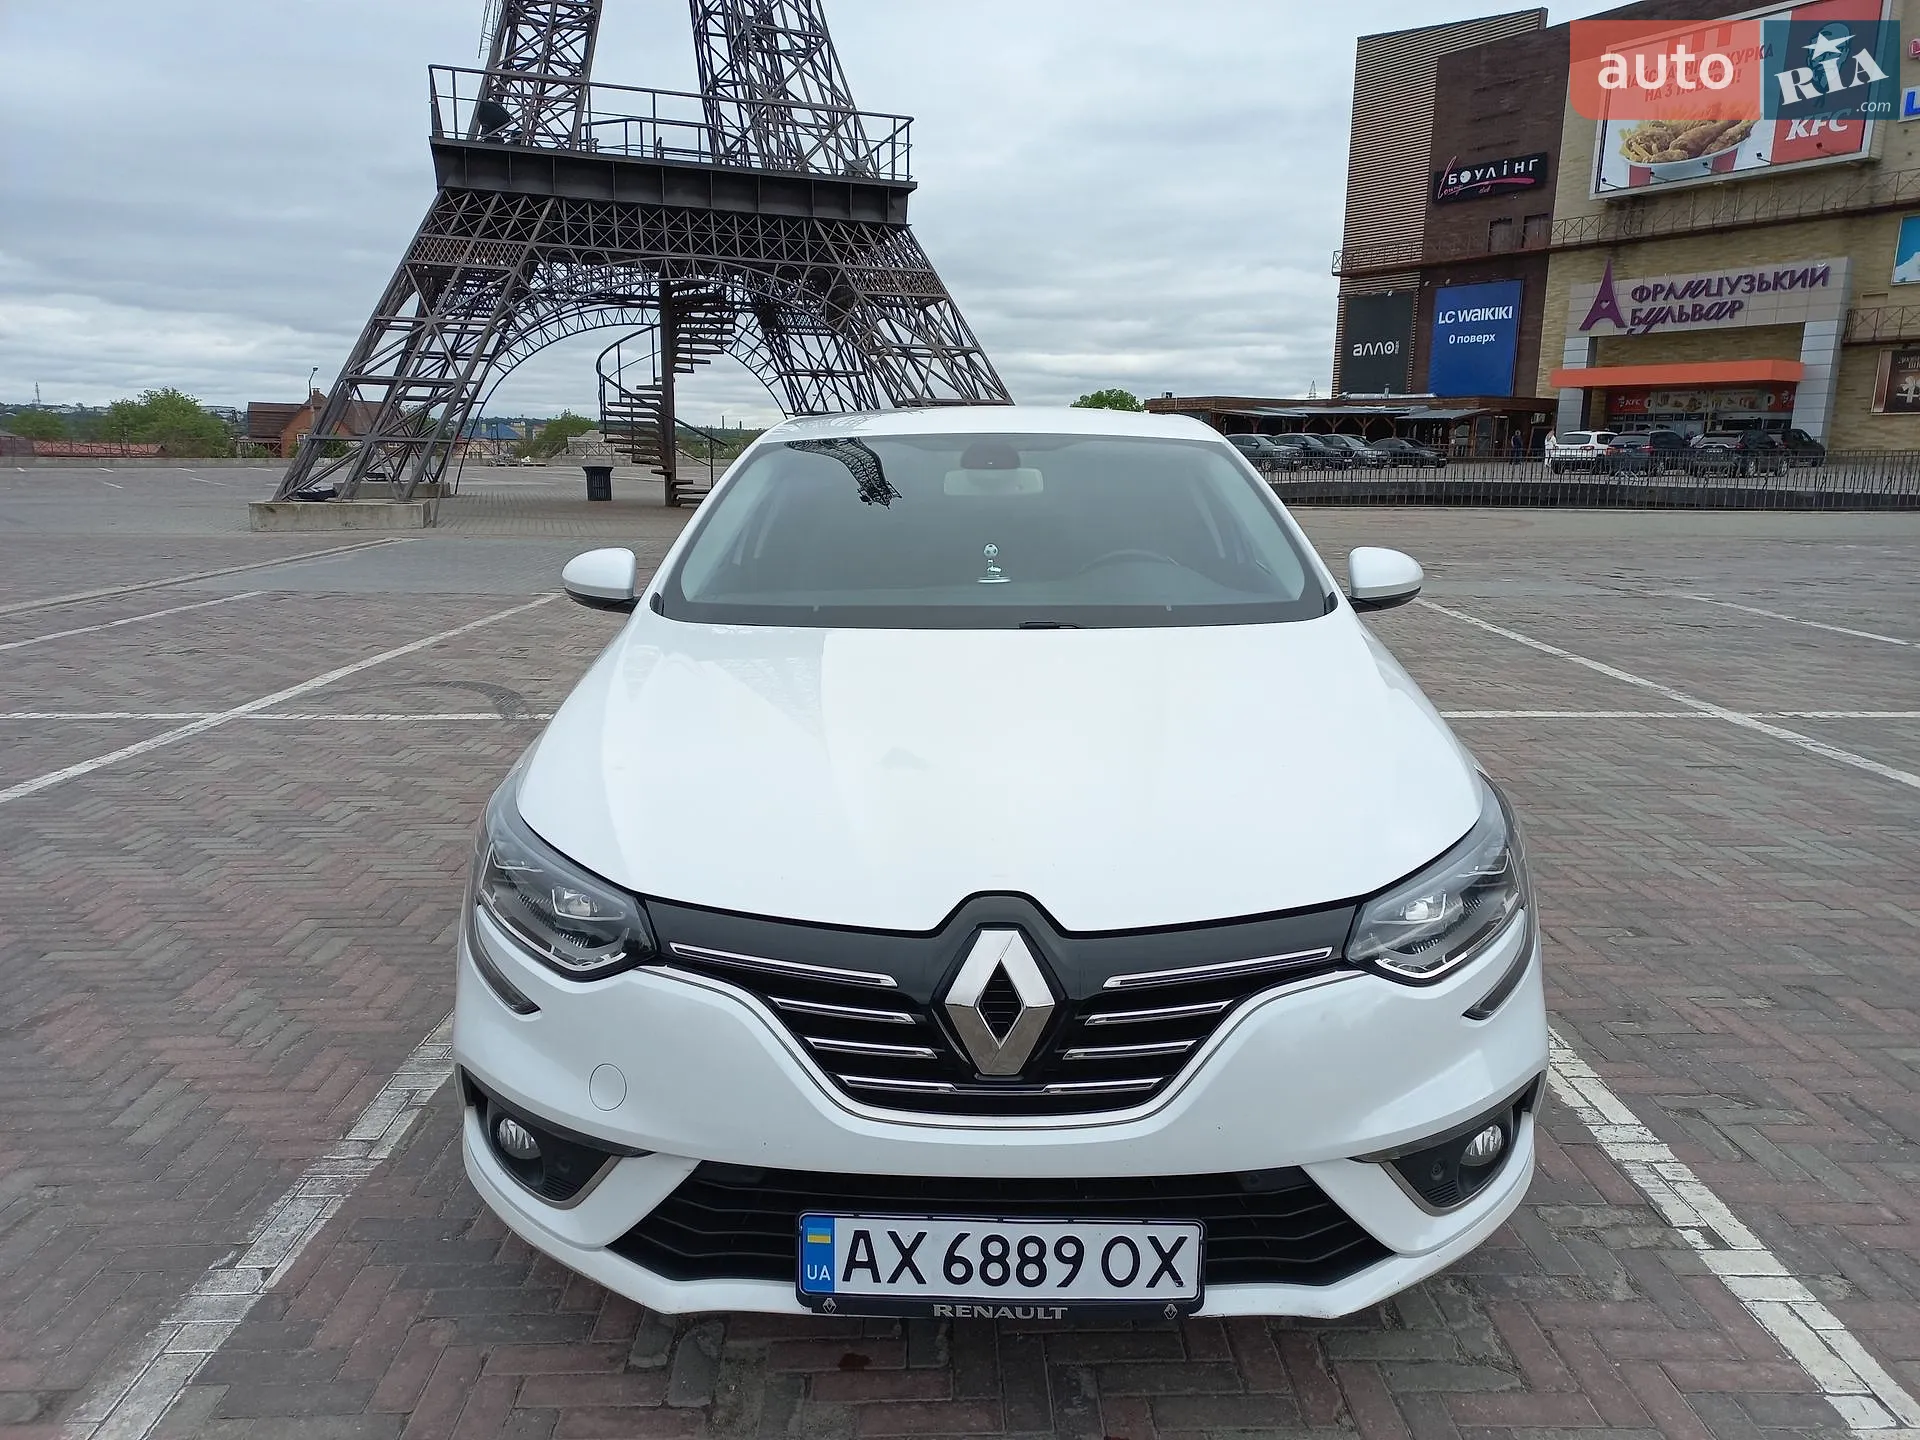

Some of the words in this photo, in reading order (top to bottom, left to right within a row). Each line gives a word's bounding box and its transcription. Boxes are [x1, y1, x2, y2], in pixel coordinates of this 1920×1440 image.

[1785, 108, 1852, 141] KFC
[1631, 263, 1832, 304] ФРАНЦУЗЬКИЙ
[1438, 310, 1456, 324] LC
[1457, 333, 1496, 345] поверх
[807, 1265, 831, 1281] UA
[842, 1230, 927, 1285] AX
[942, 1232, 1085, 1288] 6889
[1101, 1235, 1188, 1289] OX
[933, 1304, 1068, 1320] RENAULT
